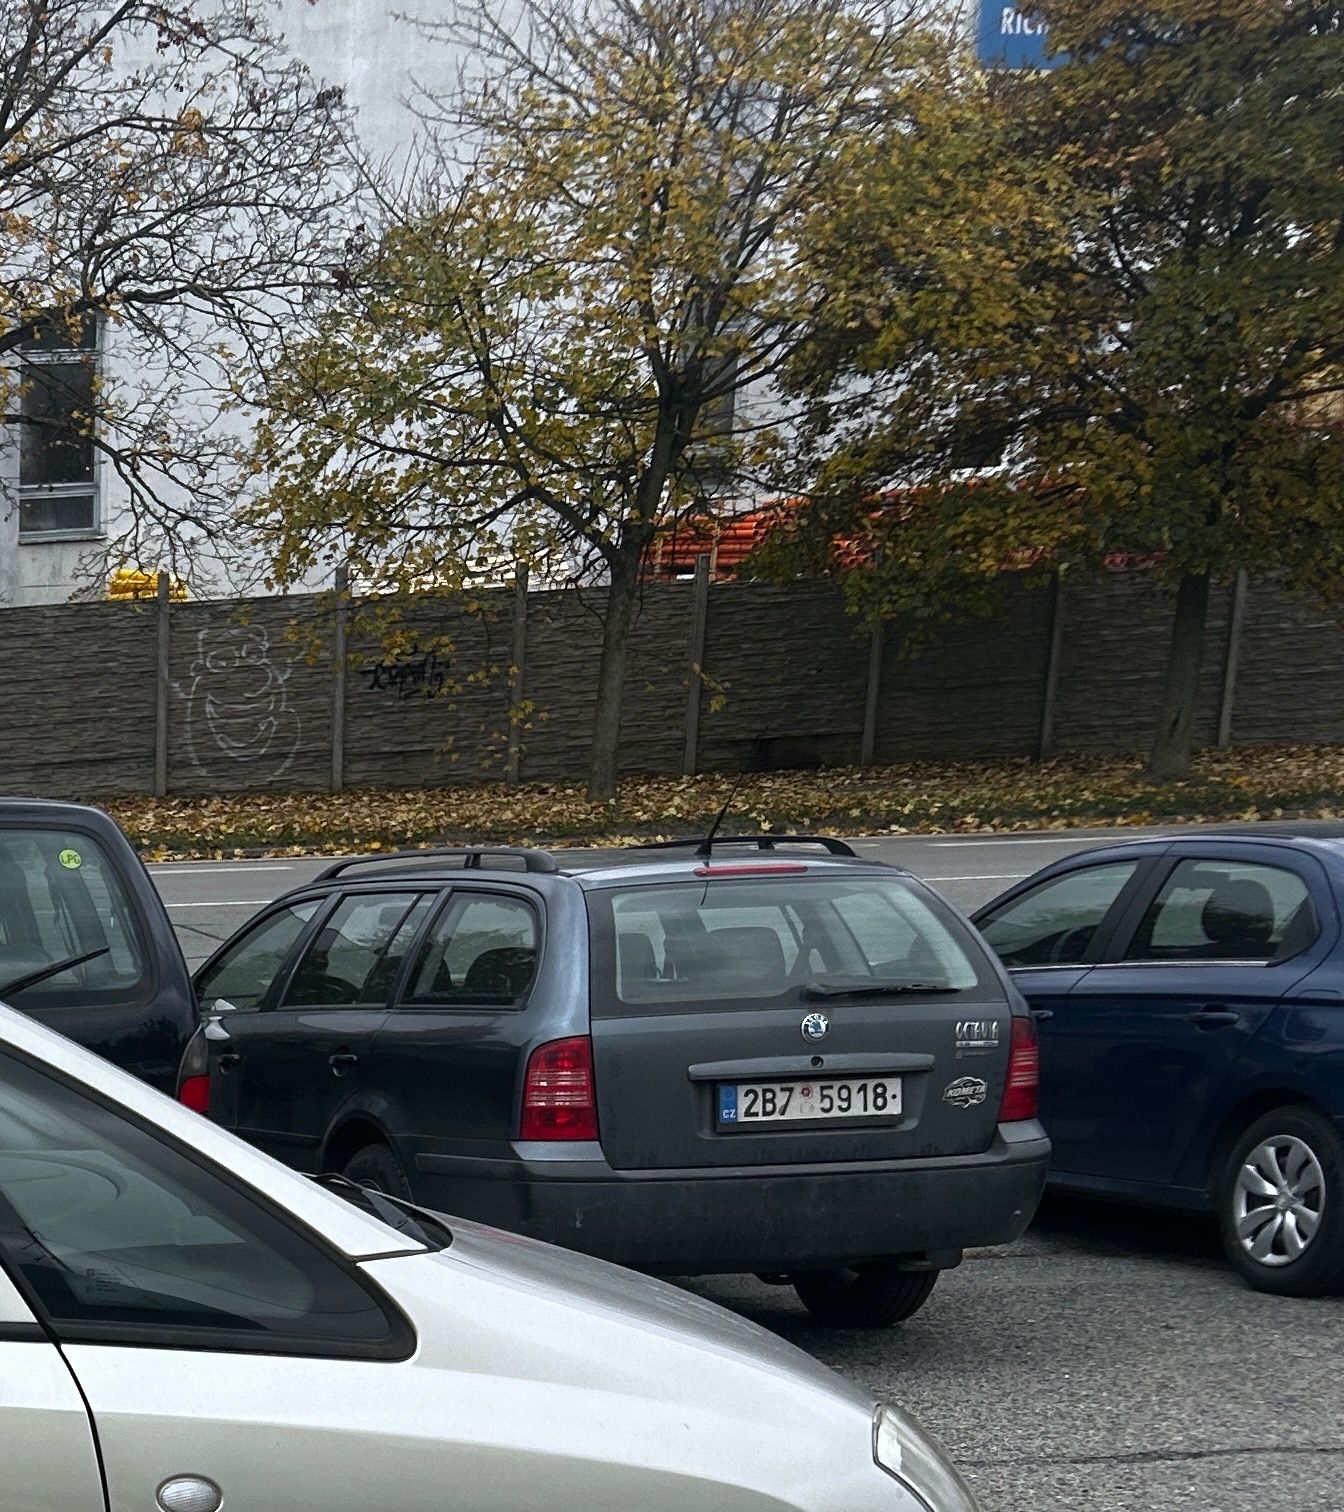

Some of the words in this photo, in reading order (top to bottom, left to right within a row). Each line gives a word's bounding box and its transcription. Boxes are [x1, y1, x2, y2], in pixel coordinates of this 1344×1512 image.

[743, 1087, 795, 1118] 2B7
[819, 1082, 888, 1114] 5918
[722, 1109, 736, 1119] CZ
